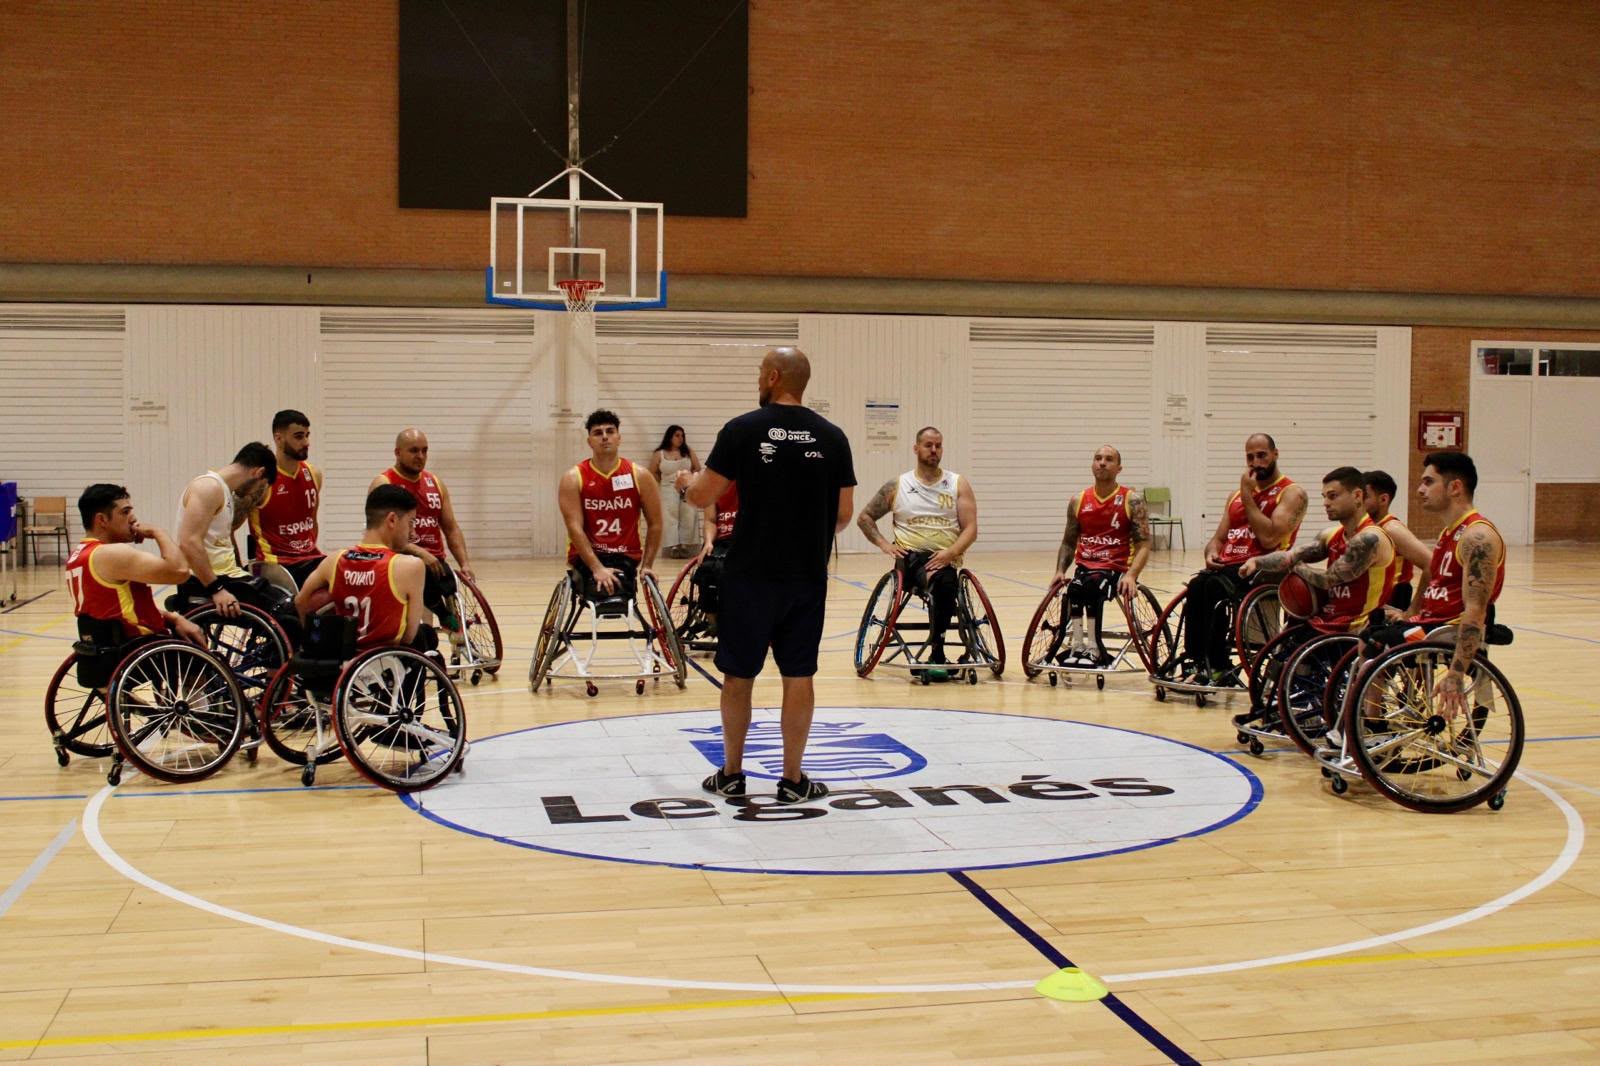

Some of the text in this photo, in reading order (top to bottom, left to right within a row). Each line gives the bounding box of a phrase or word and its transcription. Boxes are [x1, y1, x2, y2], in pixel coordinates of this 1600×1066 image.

[304, 488, 317, 509] 13
[426, 493, 441, 509] 55
[584, 496, 633, 511] ESPAÑA
[278, 517, 314, 536] ESPAÑ
[595, 518, 622, 537] 24
[1110, 512, 1121, 529] 4
[343, 570, 376, 586] POYATO
[541, 775, 1175, 824] Leganés
